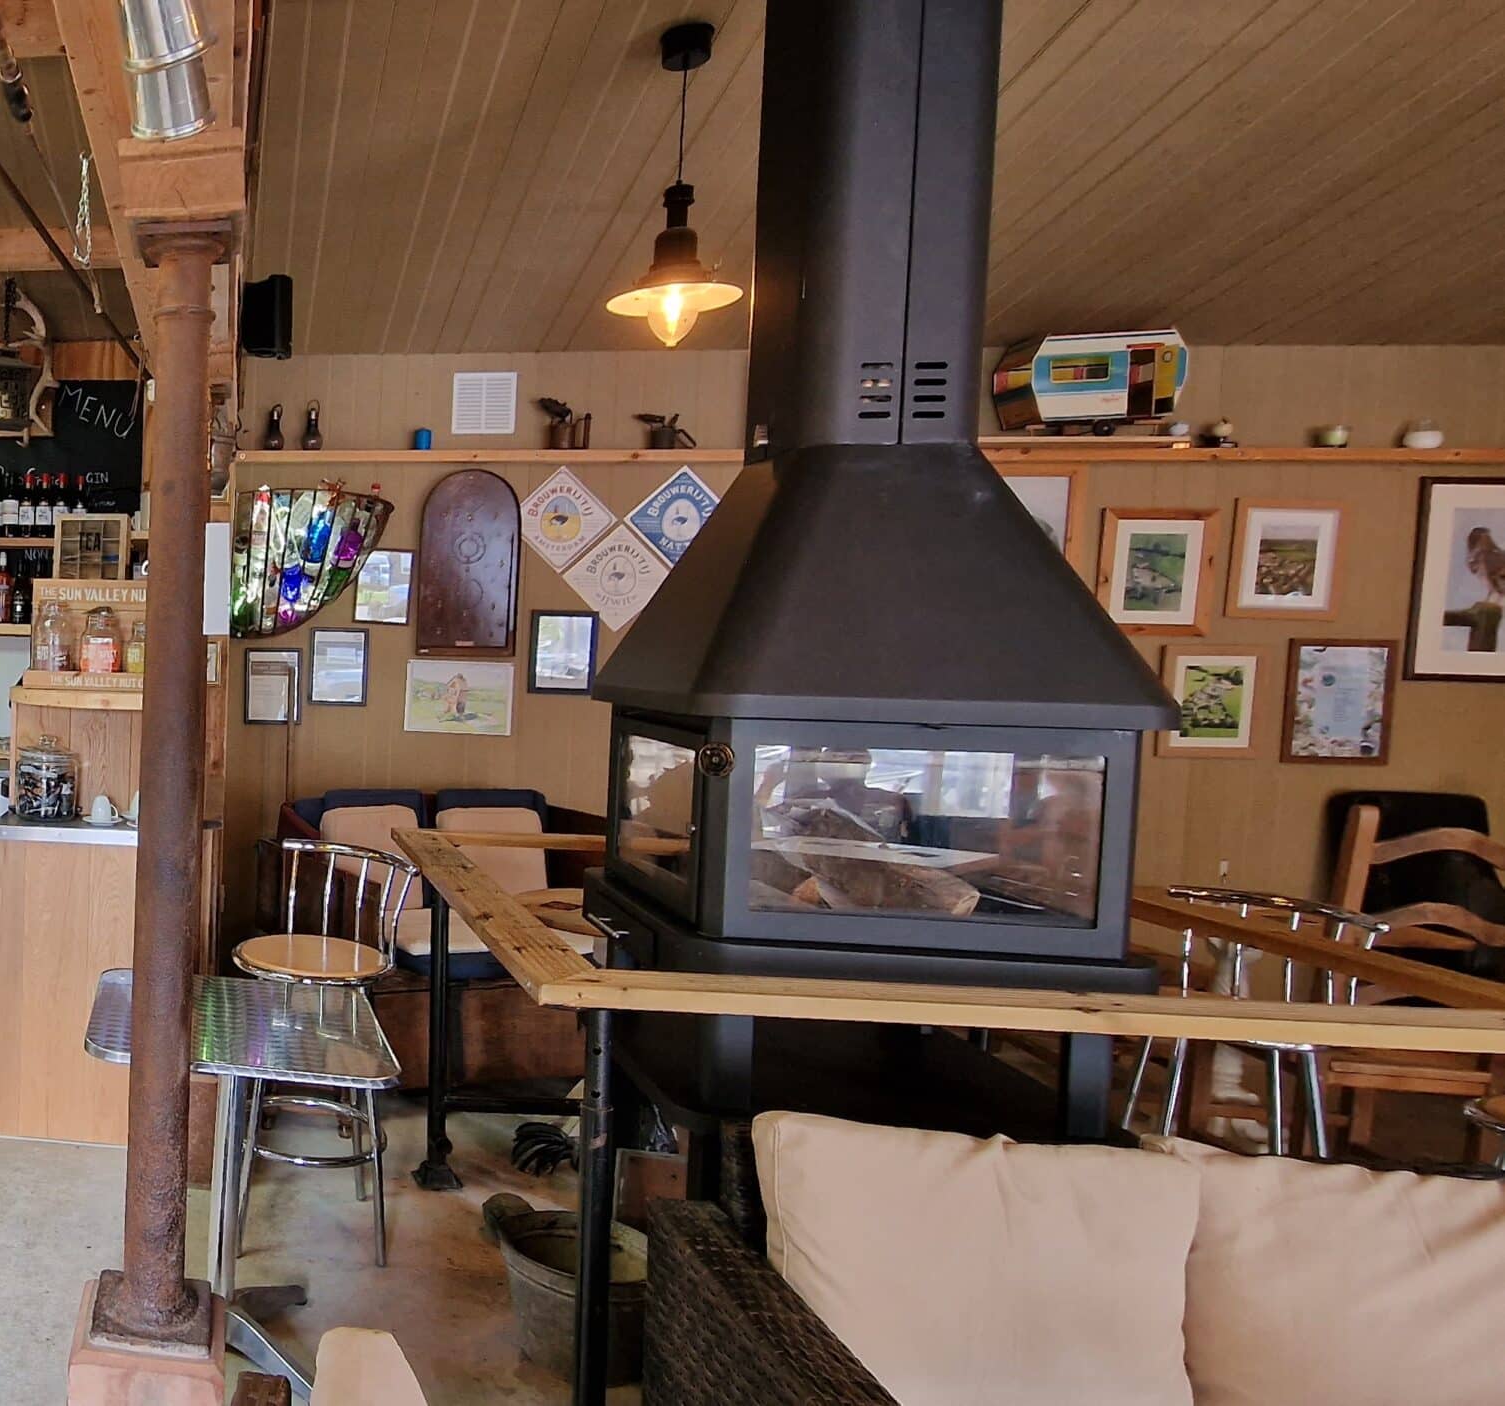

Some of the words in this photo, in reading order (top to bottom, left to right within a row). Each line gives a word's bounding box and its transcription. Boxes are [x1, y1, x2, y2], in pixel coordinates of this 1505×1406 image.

[58, 384, 136, 440] MENU
[86, 472, 109, 484] GIN
[80, 532, 101, 551] TEA
[534, 535, 587, 551] AMSTERDAM
[40, 587, 58, 597] THE
[59, 587, 82, 600] SUN
[84, 588, 128, 602] VALLEY
[64, 676, 82, 687] SUN
[84, 677, 118, 688] VALLEY
[119, 678, 135, 688] NUT
